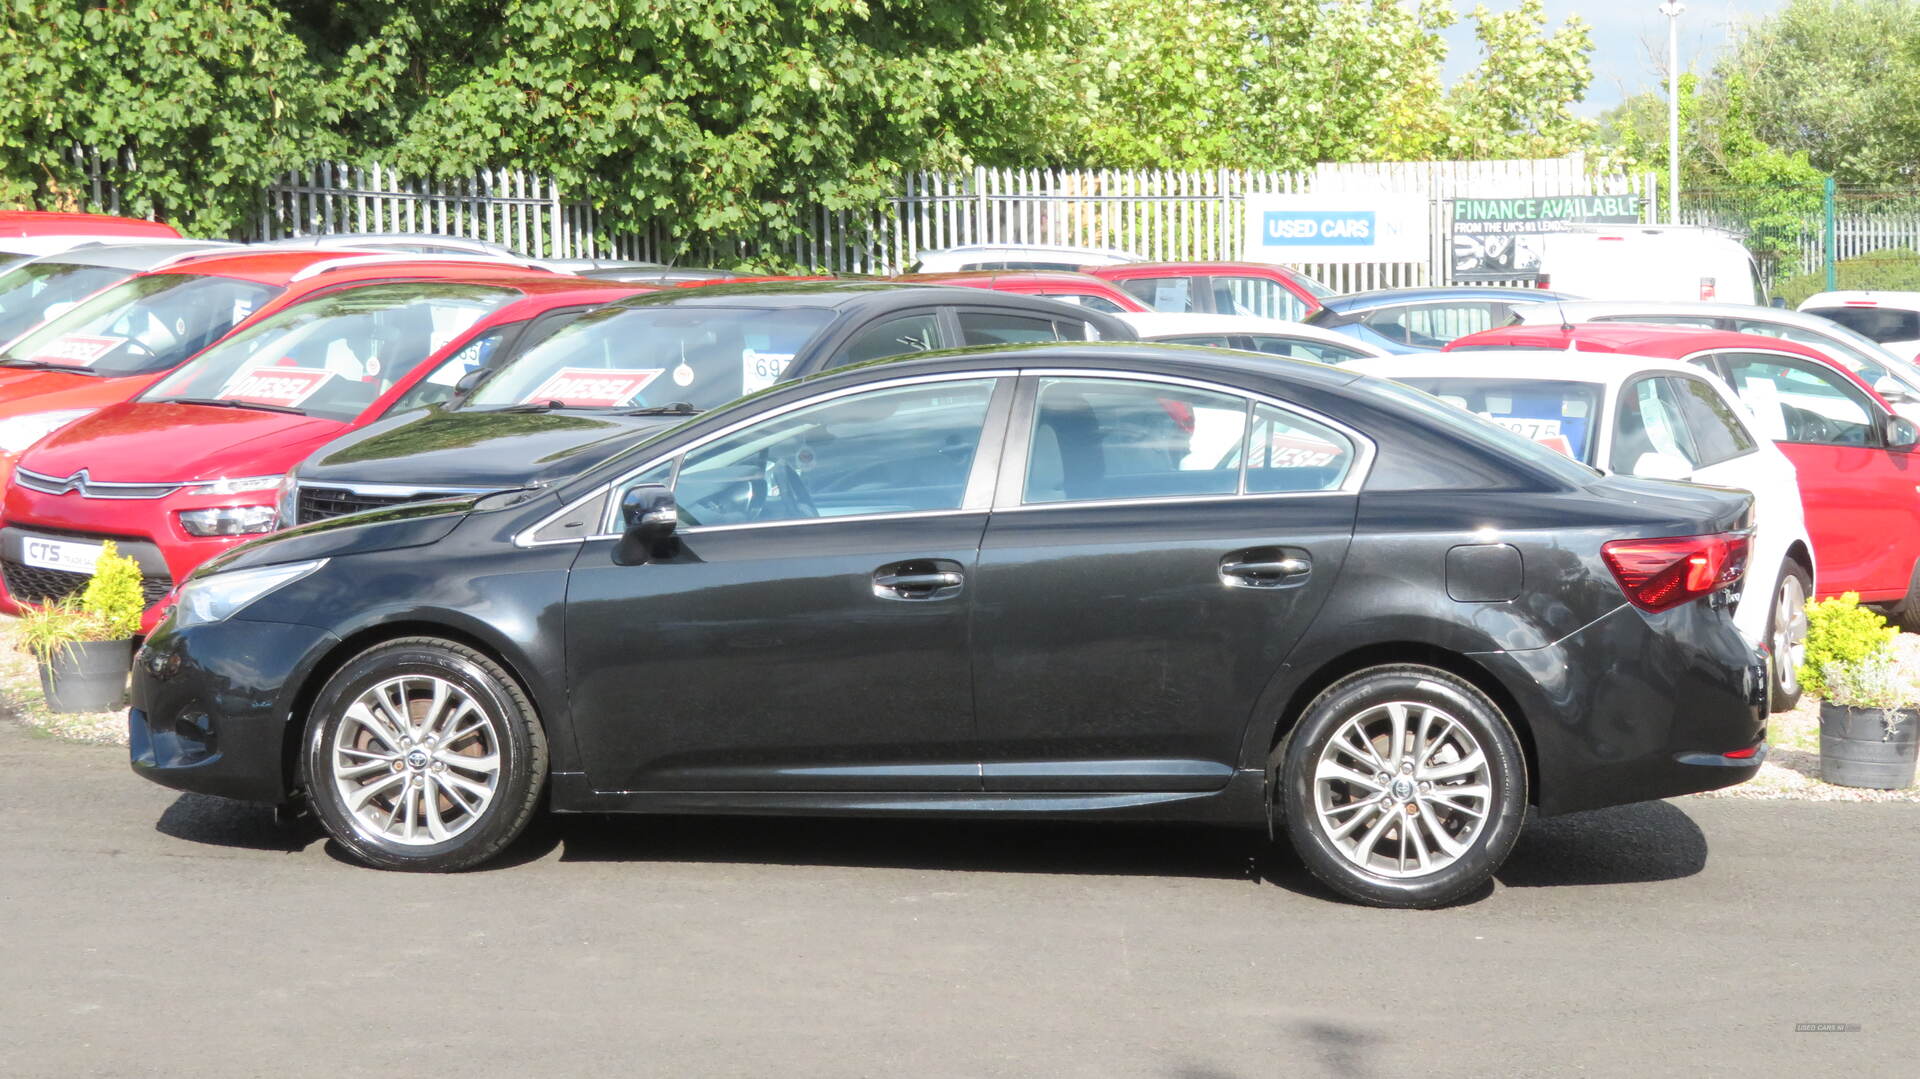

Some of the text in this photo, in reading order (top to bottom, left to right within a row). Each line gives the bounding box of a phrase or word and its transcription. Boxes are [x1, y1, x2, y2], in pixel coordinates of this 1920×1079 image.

[1455, 197, 1640, 220] FINANCE AVAILABLE
[1269, 219, 1318, 238] USED
[1320, 219, 1369, 238] CARS
[1454, 222, 1482, 233] FROM
[1484, 222, 1502, 233] THE
[1504, 221, 1524, 232] UK'S
[226, 376, 311, 399] DIESEL
[538, 378, 634, 399] DIESEL
[29, 542, 61, 562] CTS
